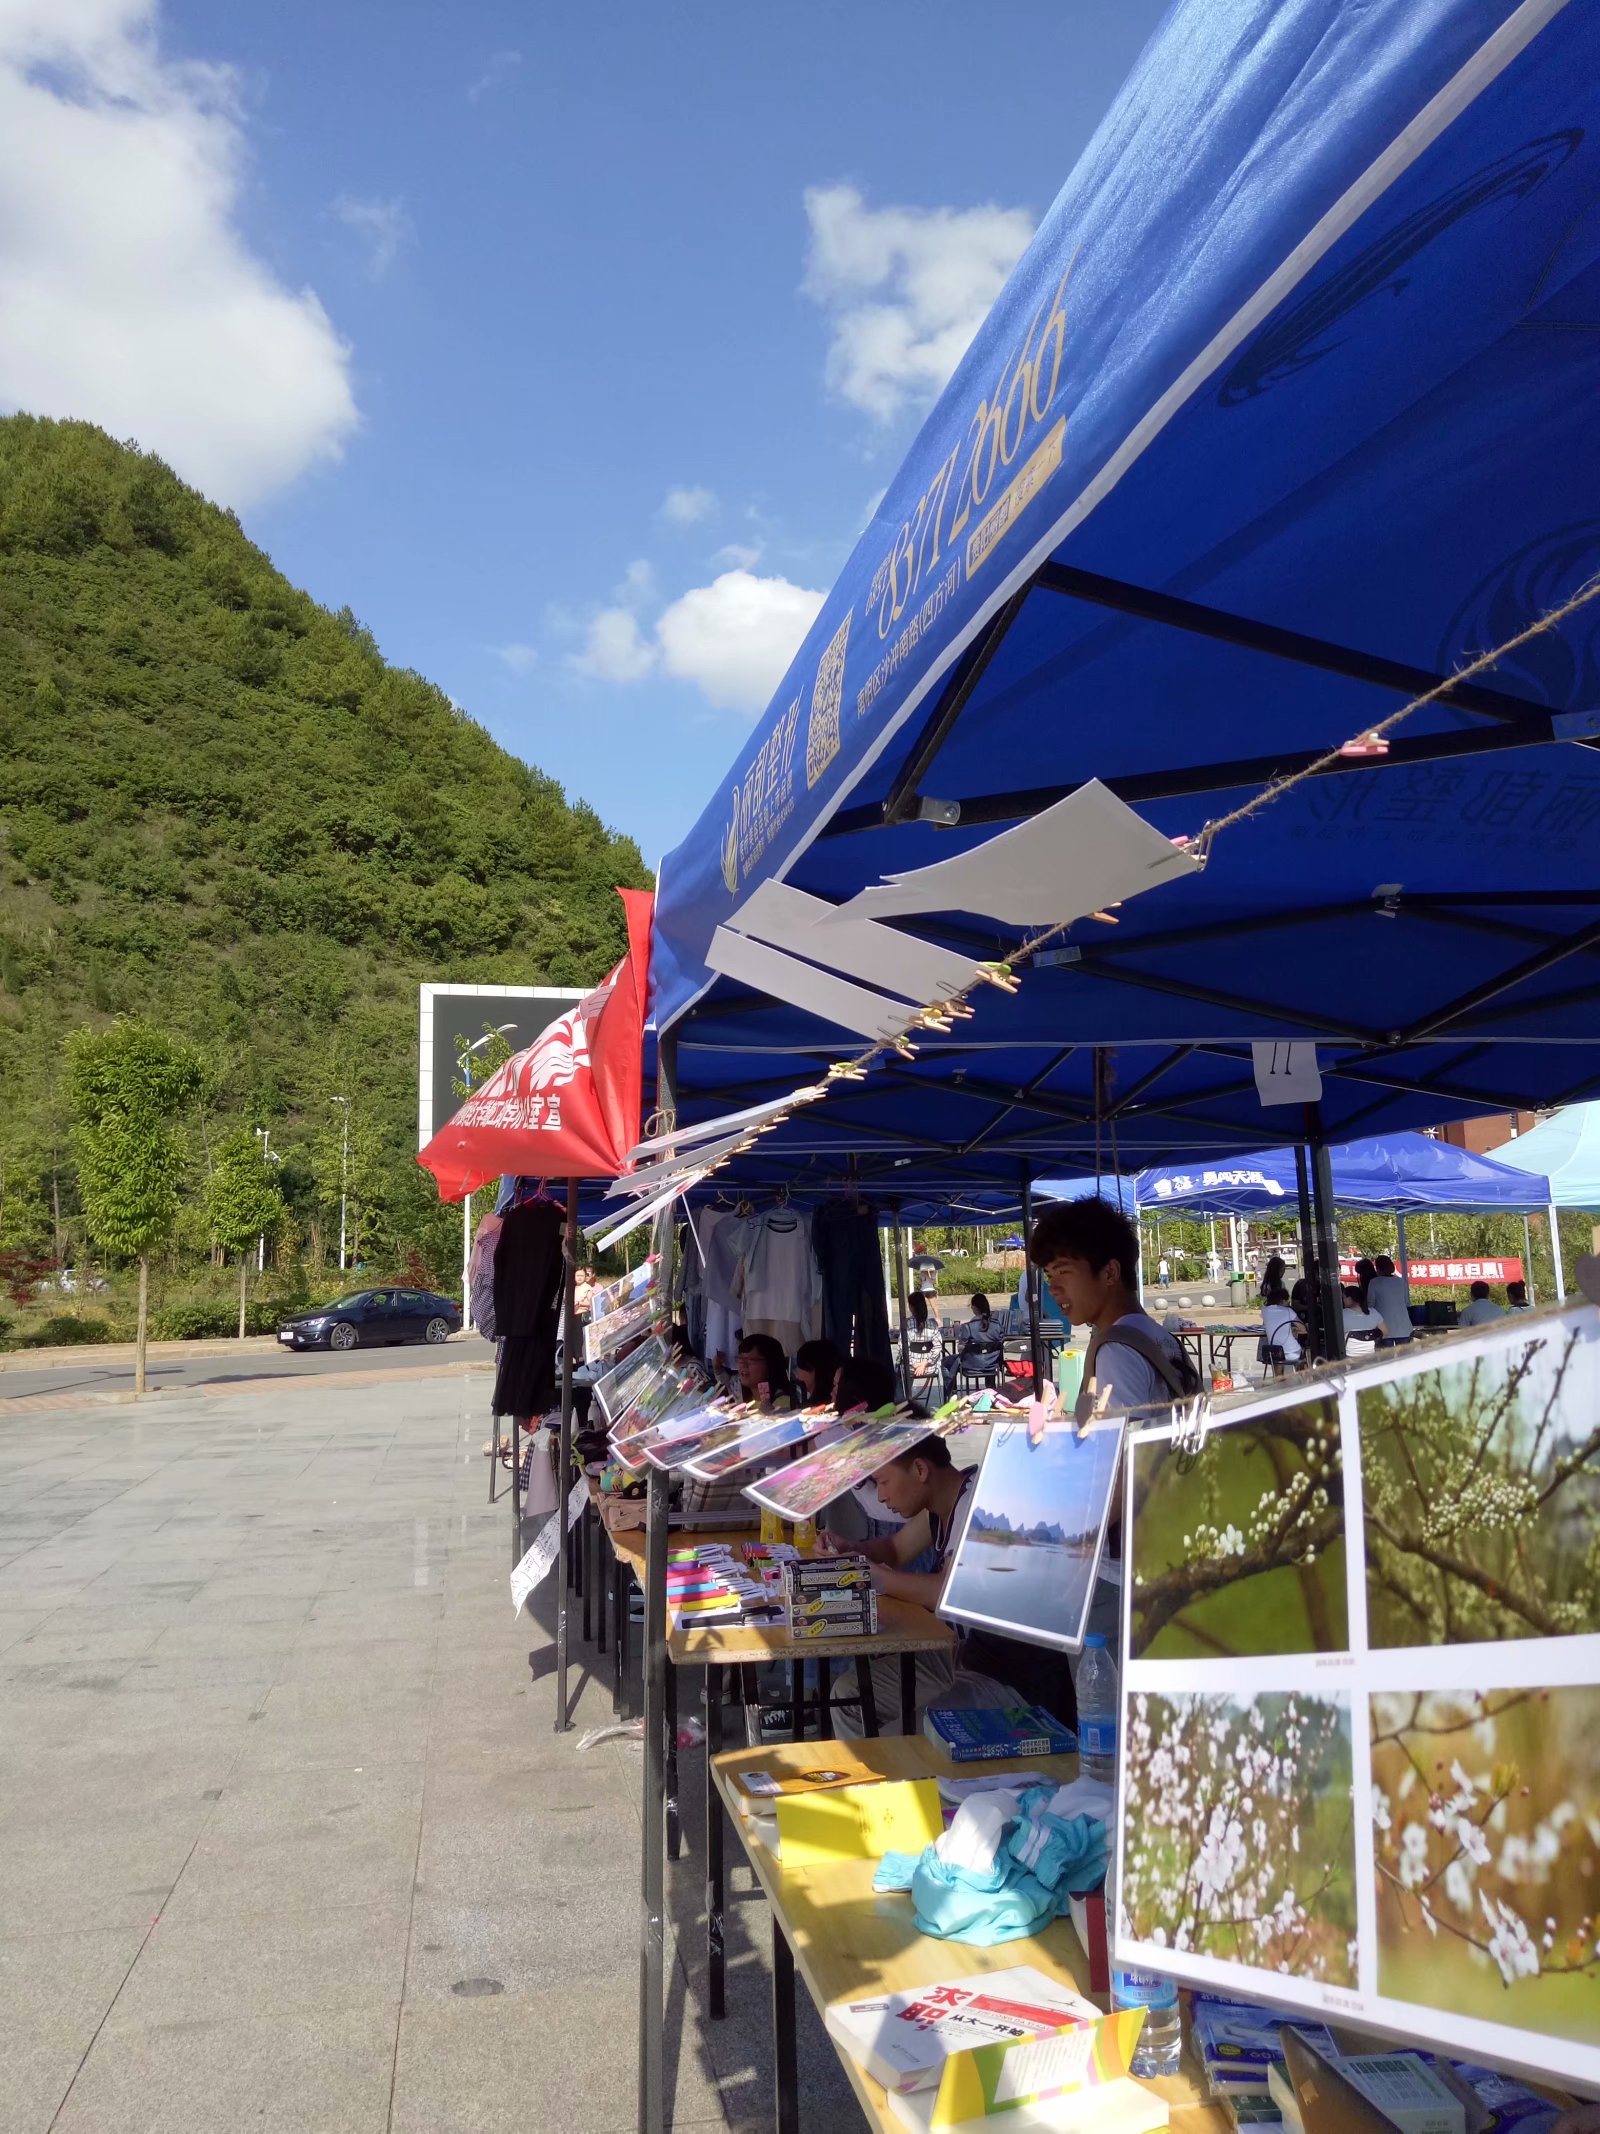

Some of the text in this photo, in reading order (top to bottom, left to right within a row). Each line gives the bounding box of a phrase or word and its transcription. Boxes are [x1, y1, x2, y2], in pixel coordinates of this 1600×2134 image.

[857, 556, 961, 720] 南明区沙冲南路(四方河)
[740, 685, 804, 836] 丽都整形
[948, 2014, 1025, 2036] 从大一开始
